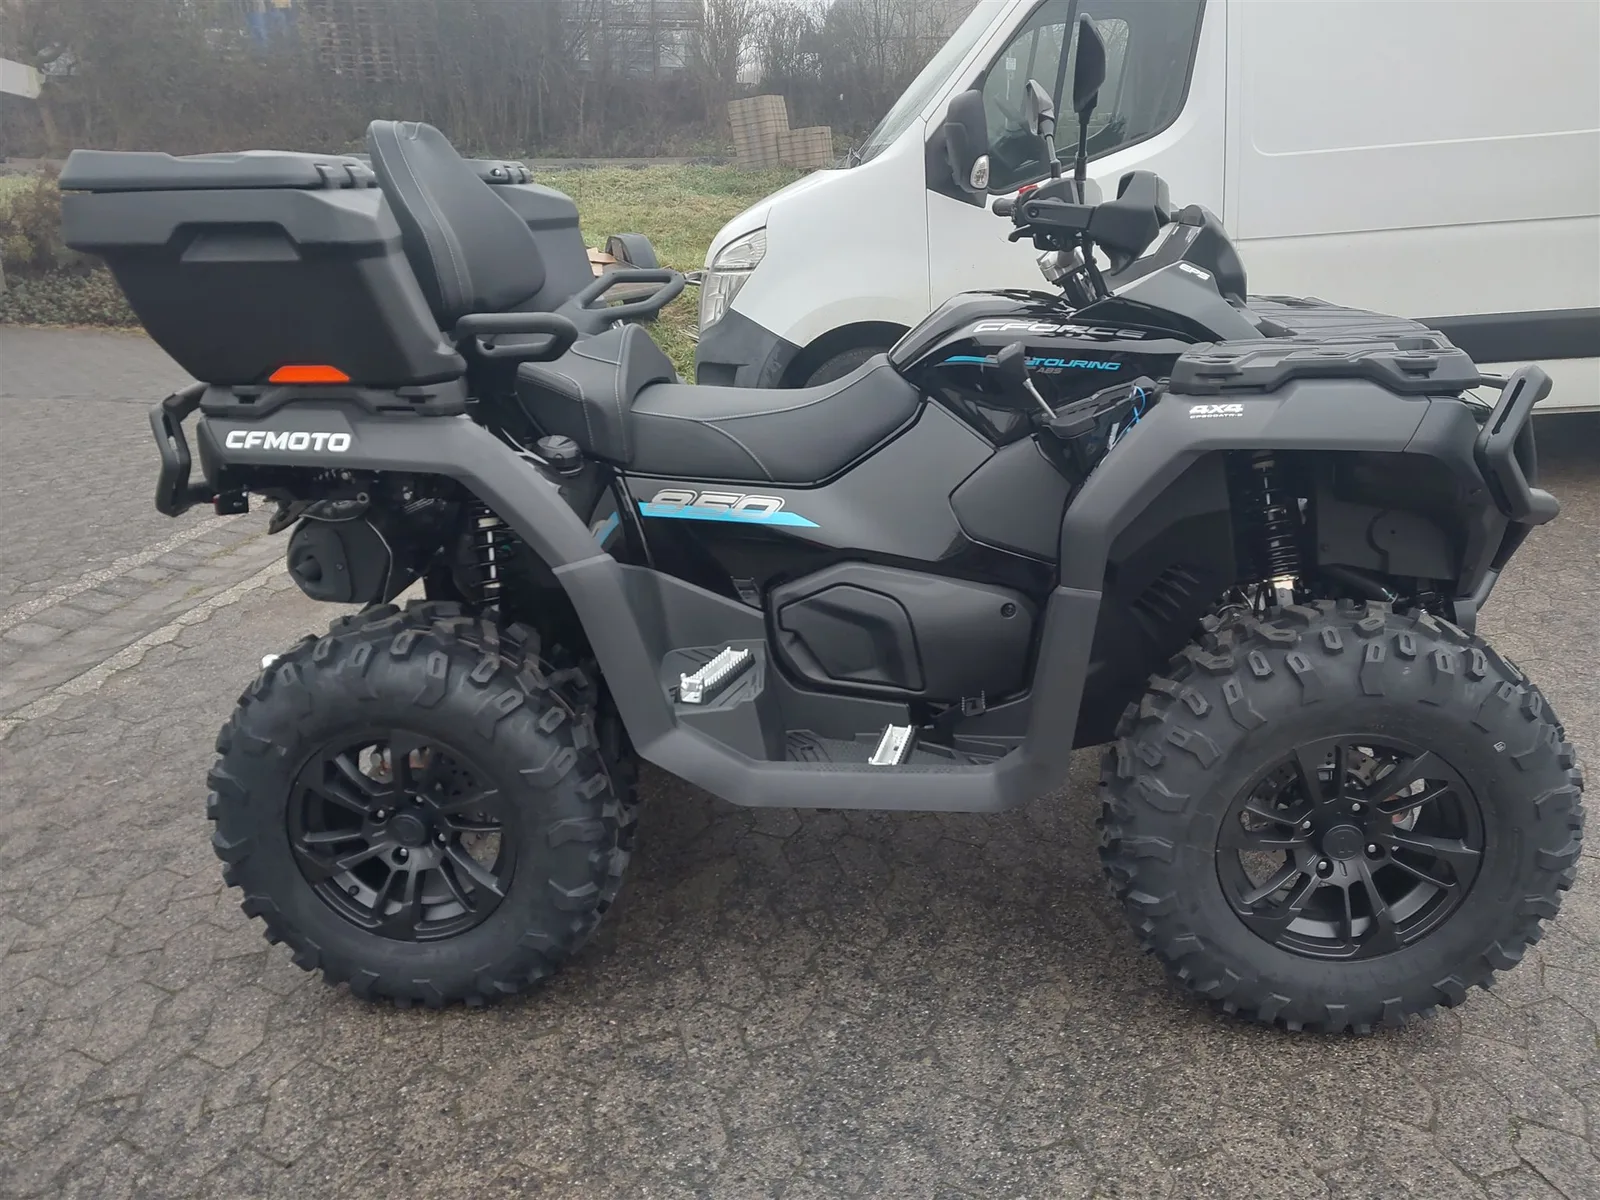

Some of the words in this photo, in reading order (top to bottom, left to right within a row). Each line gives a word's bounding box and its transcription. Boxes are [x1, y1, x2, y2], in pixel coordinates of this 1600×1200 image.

[1179, 263, 1210, 280] EPS
[973, 323, 1147, 339] CFORCE
[1032, 356, 1121, 371] TOURING
[1036, 367, 1063, 375] ABS
[225, 430, 351, 452] CFMOTO
[648, 489, 785, 519] 850
